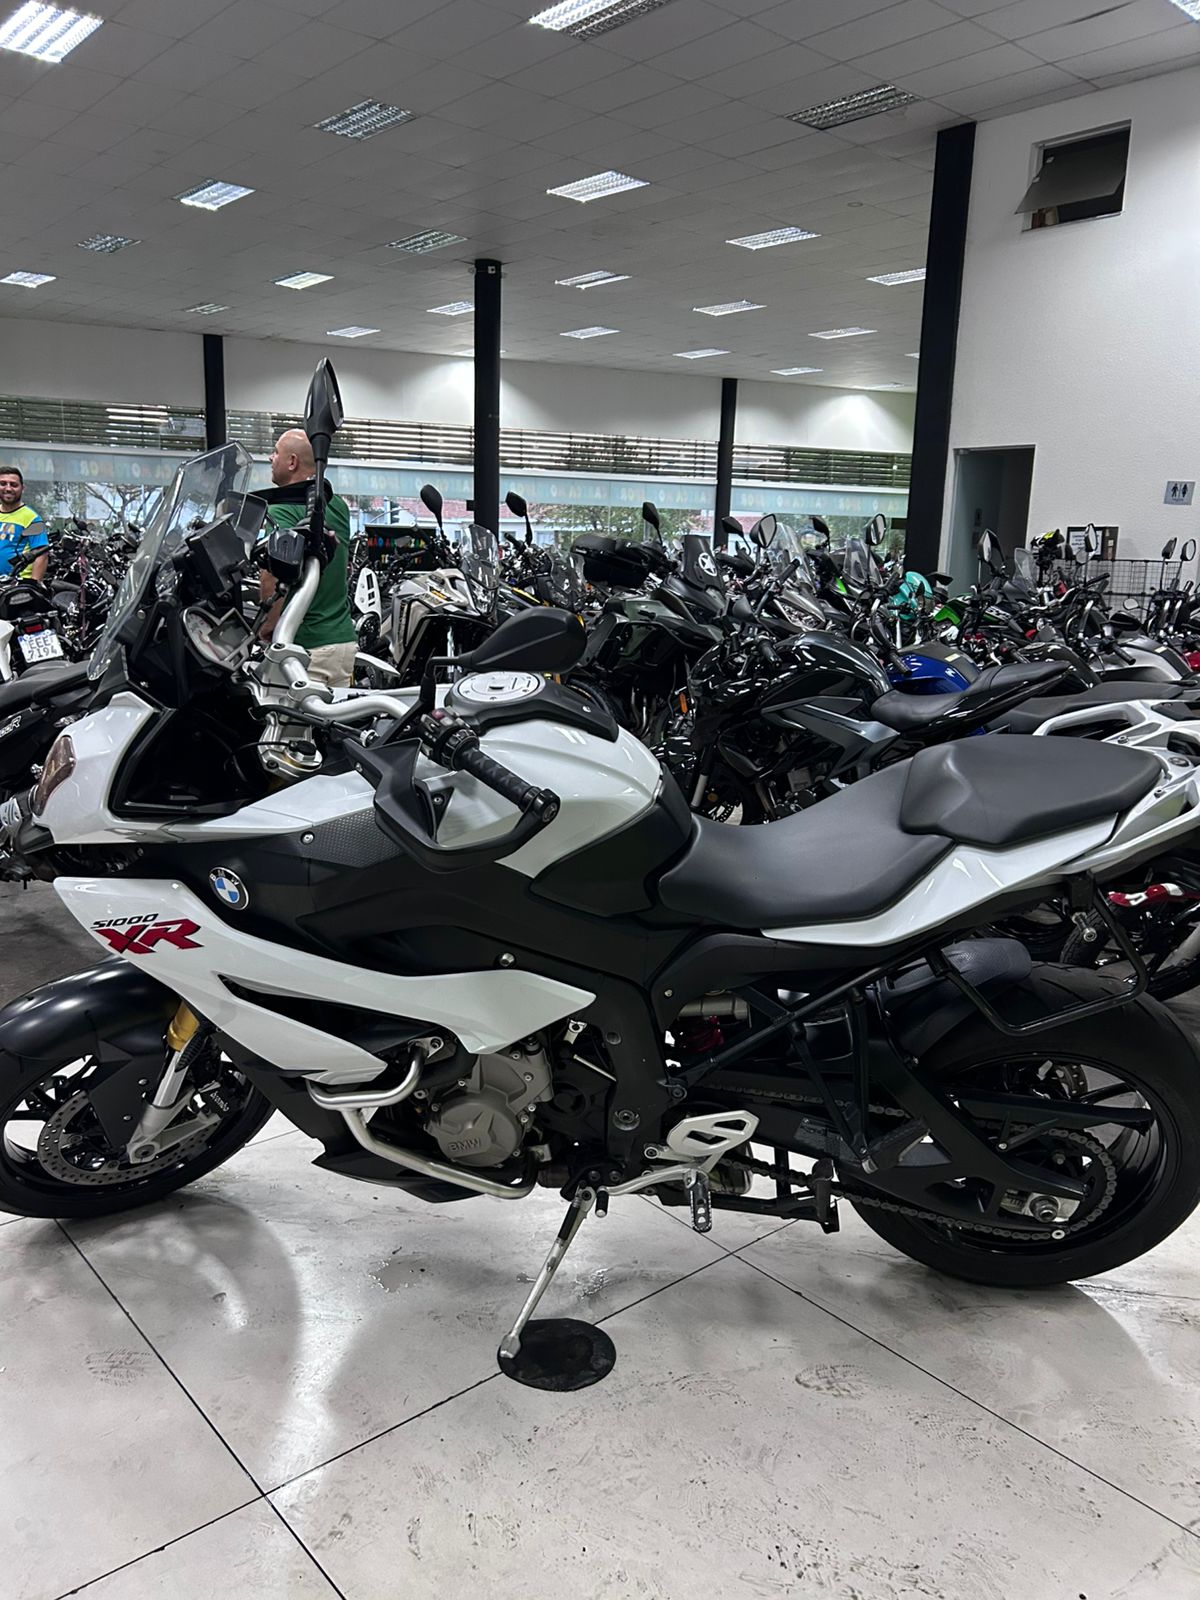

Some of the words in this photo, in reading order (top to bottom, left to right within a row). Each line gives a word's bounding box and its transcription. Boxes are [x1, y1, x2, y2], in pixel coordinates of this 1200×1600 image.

[91, 913, 159, 930] S1000
[93, 918, 205, 955] XR
[447, 1137, 481, 1151] BMW
